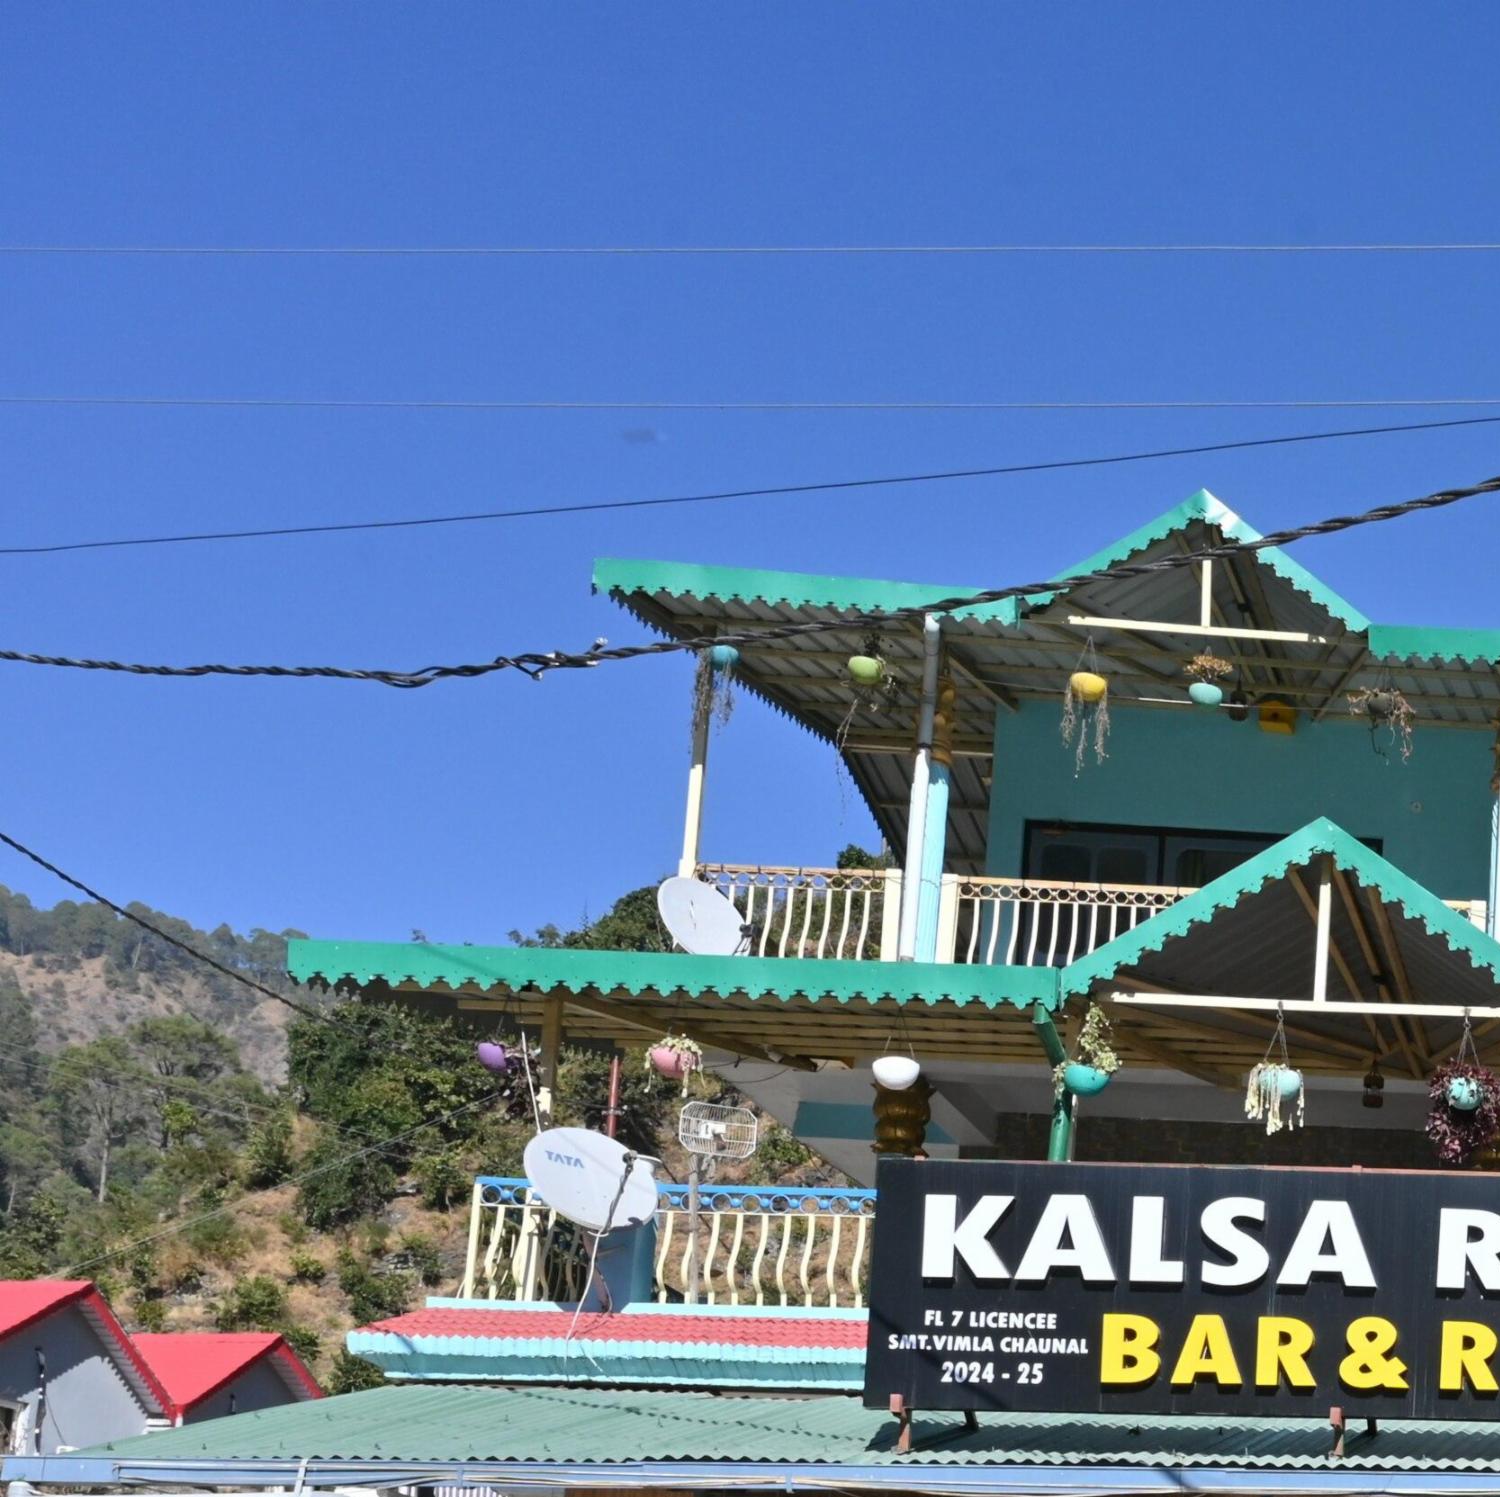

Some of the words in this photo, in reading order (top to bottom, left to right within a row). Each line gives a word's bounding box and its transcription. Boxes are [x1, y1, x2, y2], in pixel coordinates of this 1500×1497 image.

[545, 1150, 585, 1169] TATA
[921, 1193, 1378, 1291] KALSA
[924, 1310, 945, 1328] FL
[950, 1311, 963, 1328] 7
[969, 1311, 1058, 1330] LICENCEE
[999, 1336, 1089, 1354] CHAUNAL
[1101, 1313, 1317, 1390] BAR
[1338, 1316, 1411, 1392] &
[941, 1361, 994, 1383] 2024
[1016, 1363, 1044, 1384] 25
